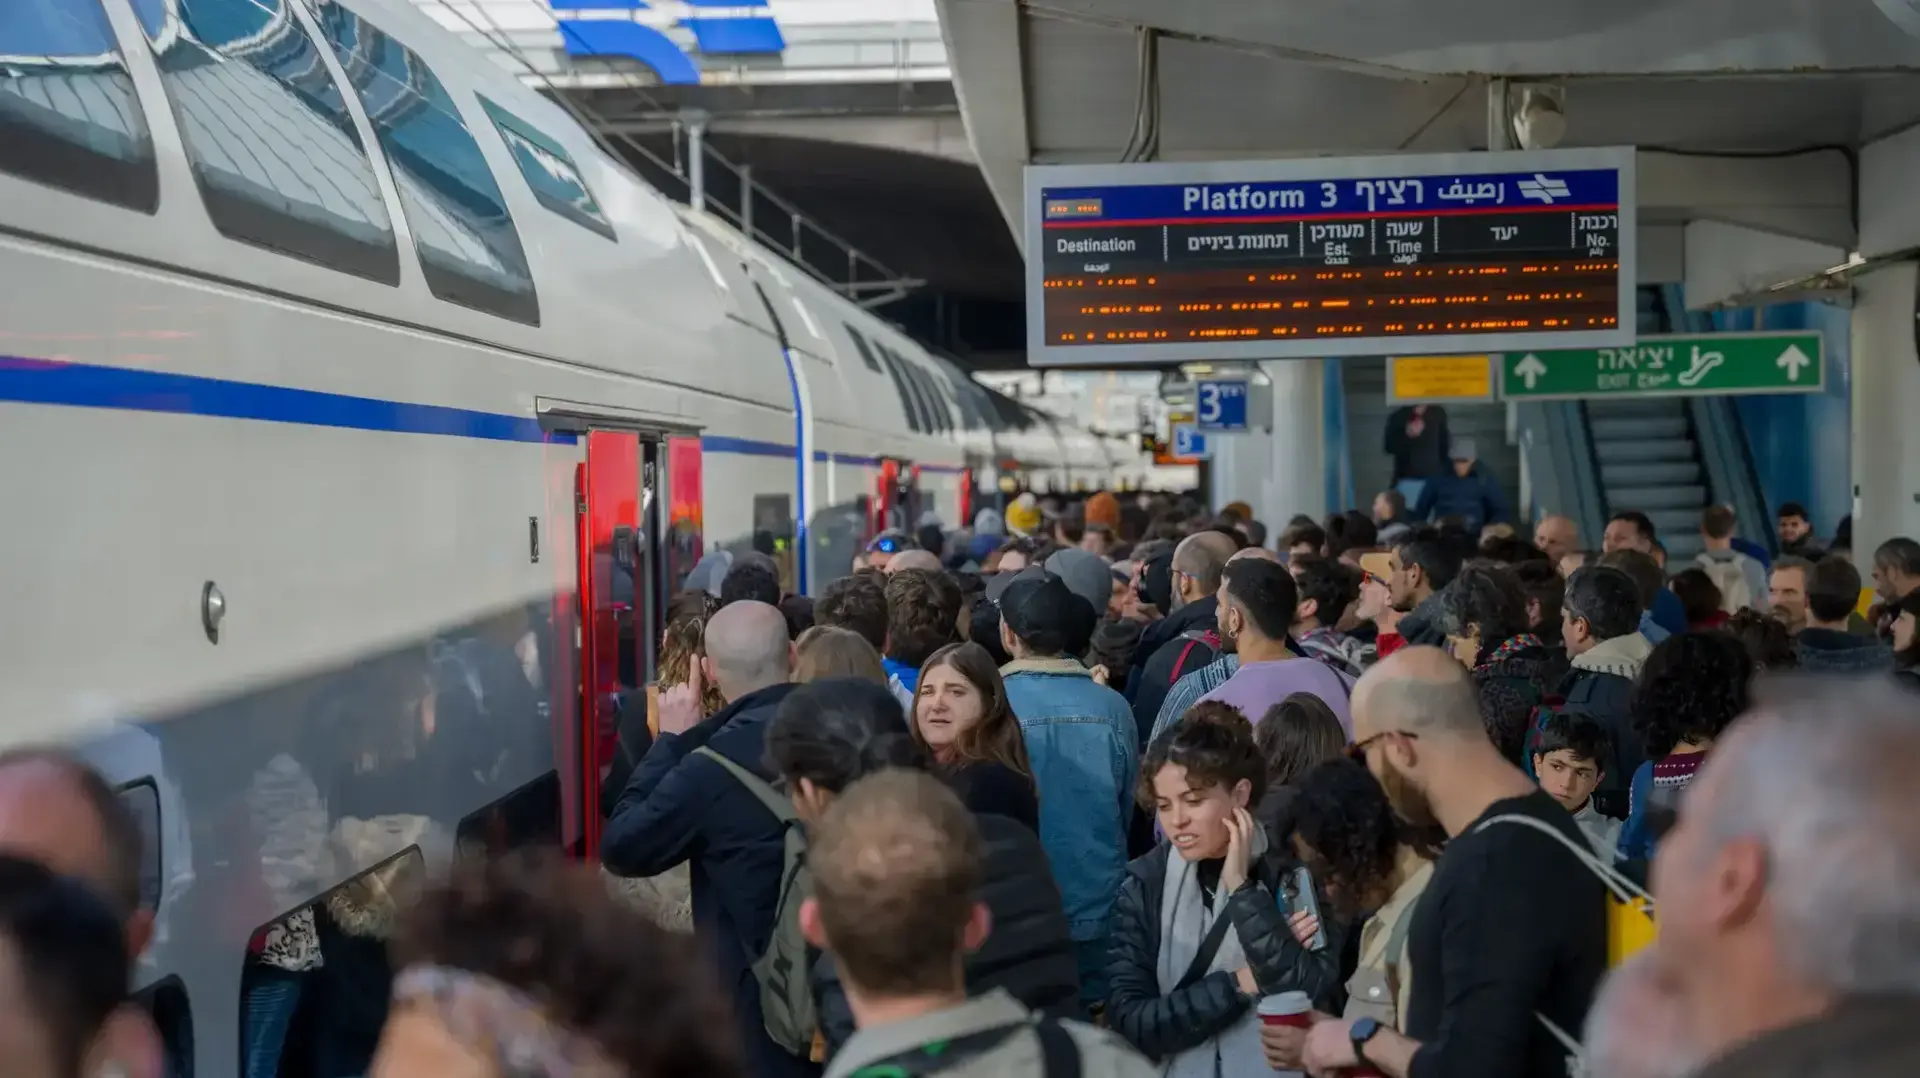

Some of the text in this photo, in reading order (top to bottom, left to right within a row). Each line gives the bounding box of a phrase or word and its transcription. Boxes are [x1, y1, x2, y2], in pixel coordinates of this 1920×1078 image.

[1183, 182, 1338, 211] Platform 3
[1355, 179, 1424, 211] רציף
[1437, 178, 1505, 204] رصيف
[1386, 221, 1423, 237] שעה
[1578, 215, 1618, 230] רכבת
[1309, 223, 1365, 243] מעודכן
[1490, 226, 1519, 241] יעד
[1586, 232, 1611, 247] No.
[1057, 237, 1136, 253] Destination
[1187, 233, 1289, 251] תחנות ביניים
[1386, 239, 1423, 254] Time
[1597, 345, 1674, 370] יציאה
